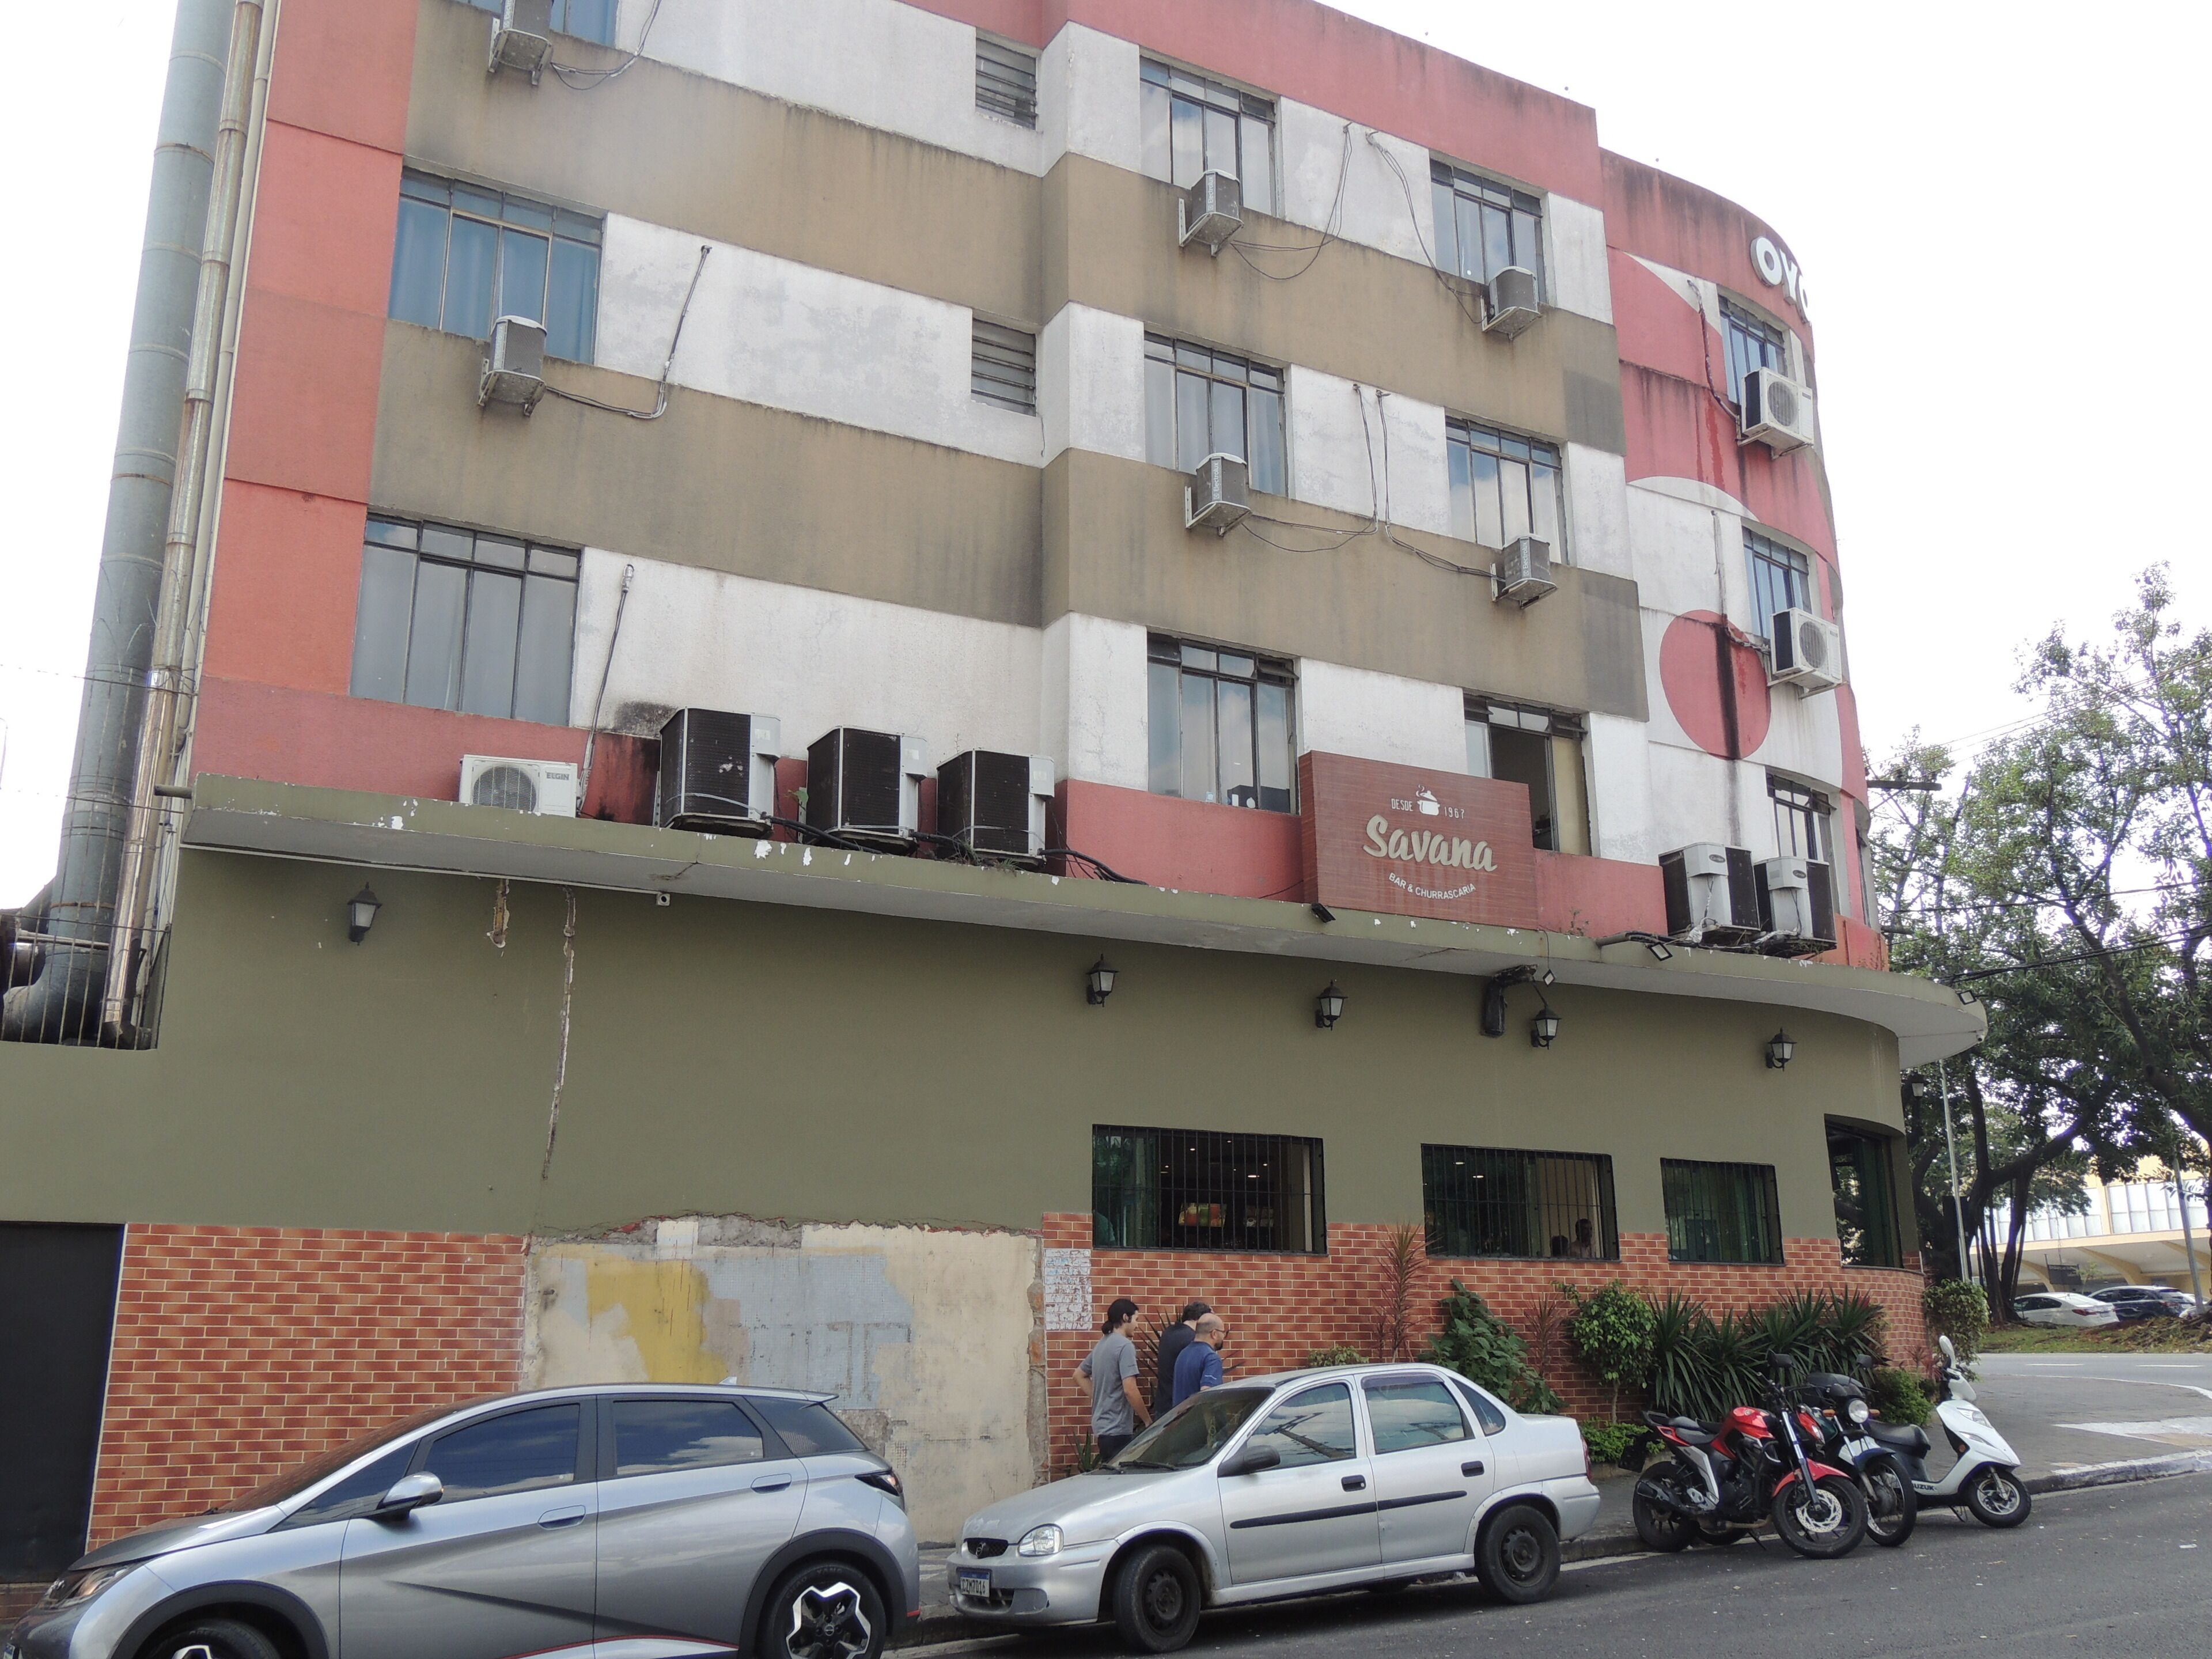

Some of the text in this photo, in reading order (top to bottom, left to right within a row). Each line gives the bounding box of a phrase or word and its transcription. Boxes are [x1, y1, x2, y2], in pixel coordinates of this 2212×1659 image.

[547, 772, 570, 781] ELGIN
[1391, 798, 1465, 819] DESDE 1967
[1363, 815, 1498, 872] Savana
[1389, 873, 1476, 899] BAR & CHURRASCARIA
